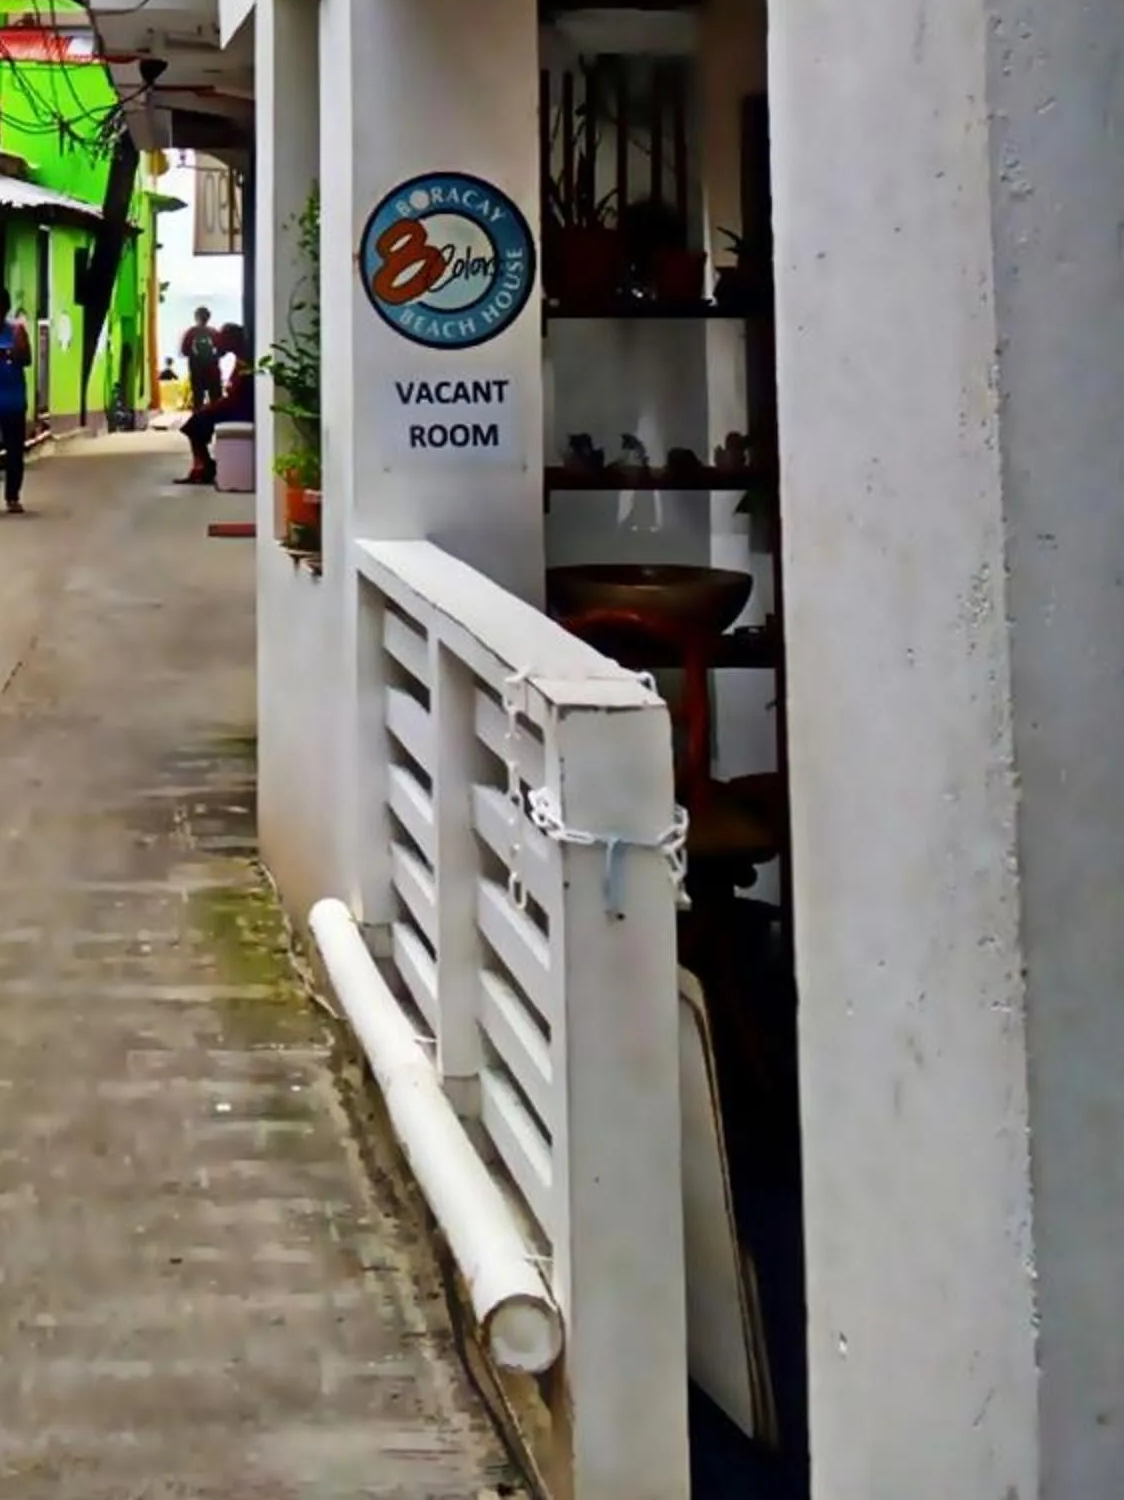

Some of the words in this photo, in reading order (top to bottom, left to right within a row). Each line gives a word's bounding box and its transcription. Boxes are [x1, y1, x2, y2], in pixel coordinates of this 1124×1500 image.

[396, 187, 505, 222] BORACAY
[373, 218, 446, 306] 8
[399, 308, 476, 338] BEACH
[481, 248, 524, 323] HOUSE
[395, 380, 509, 404] VACANT
[409, 423, 499, 448] ROOM
